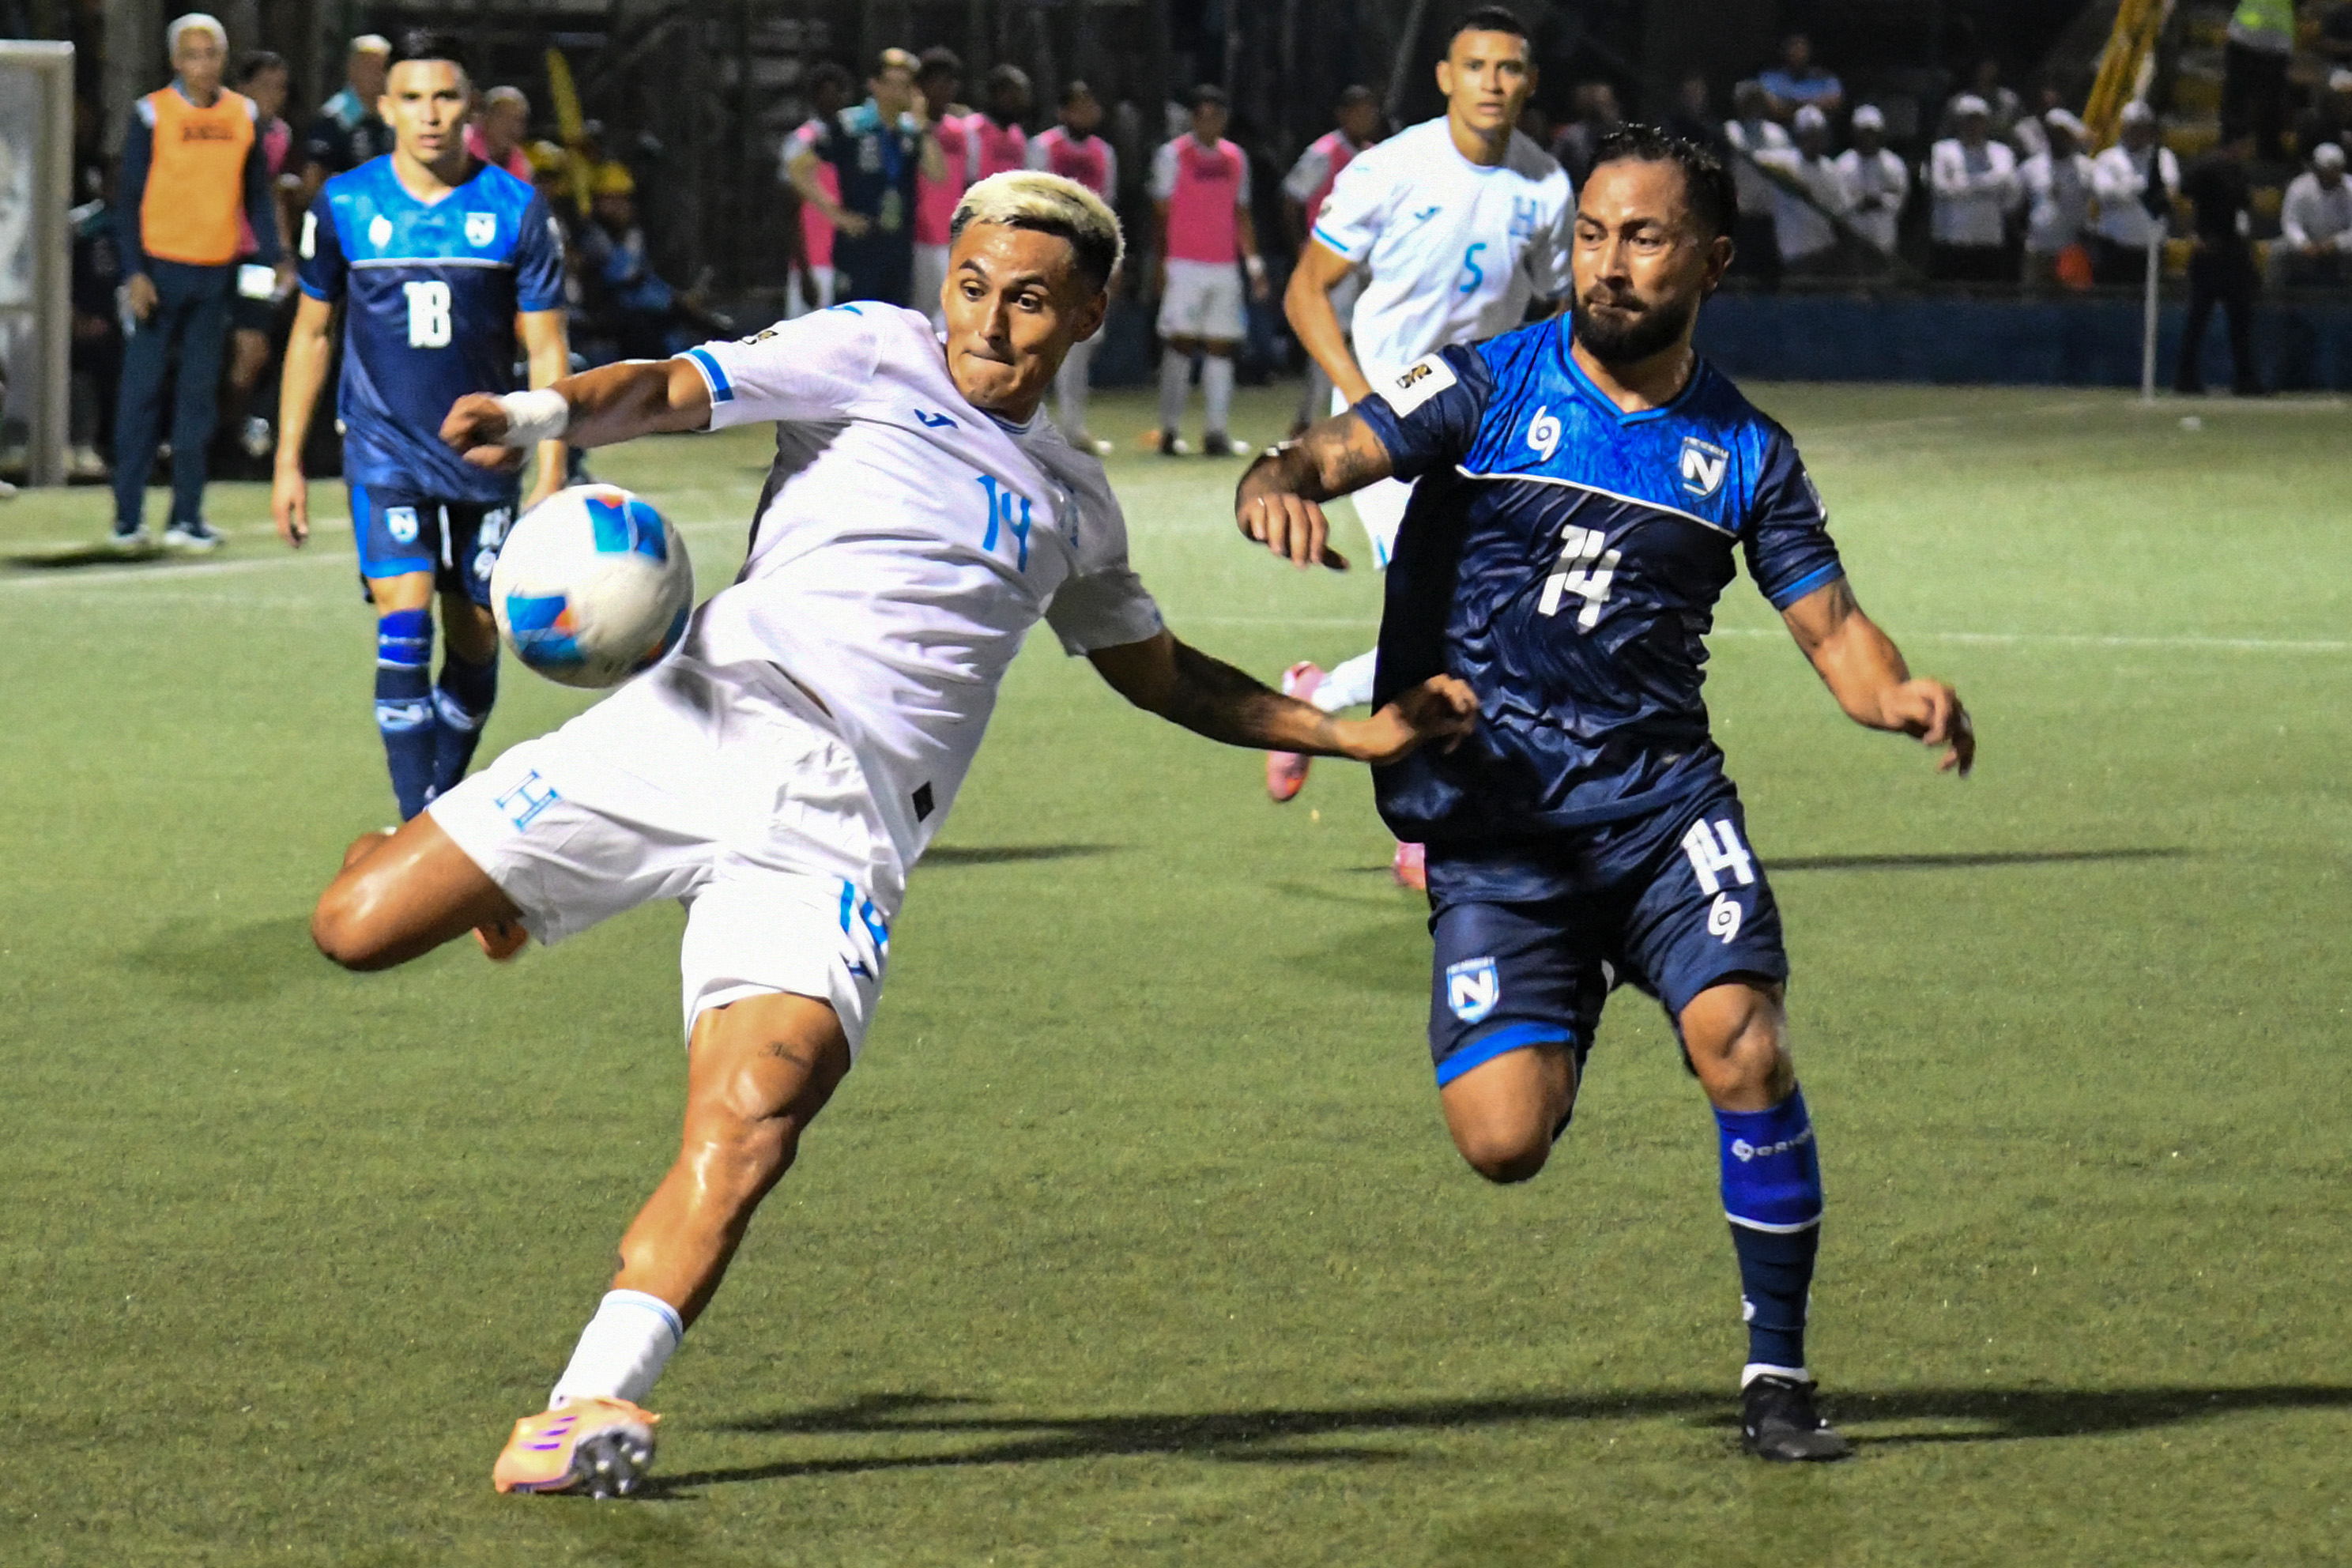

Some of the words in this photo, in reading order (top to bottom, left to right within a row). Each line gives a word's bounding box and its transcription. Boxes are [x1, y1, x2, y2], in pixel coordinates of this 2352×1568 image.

[1461, 243, 1487, 292] 5
[403, 281, 451, 348] 18
[1683, 449, 1723, 492] N
[976, 474, 1031, 574] 14
[1538, 524, 1622, 629] 14
[494, 768, 563, 835] H
[1681, 817, 1755, 896] 14
[1451, 968, 1494, 1010] N
